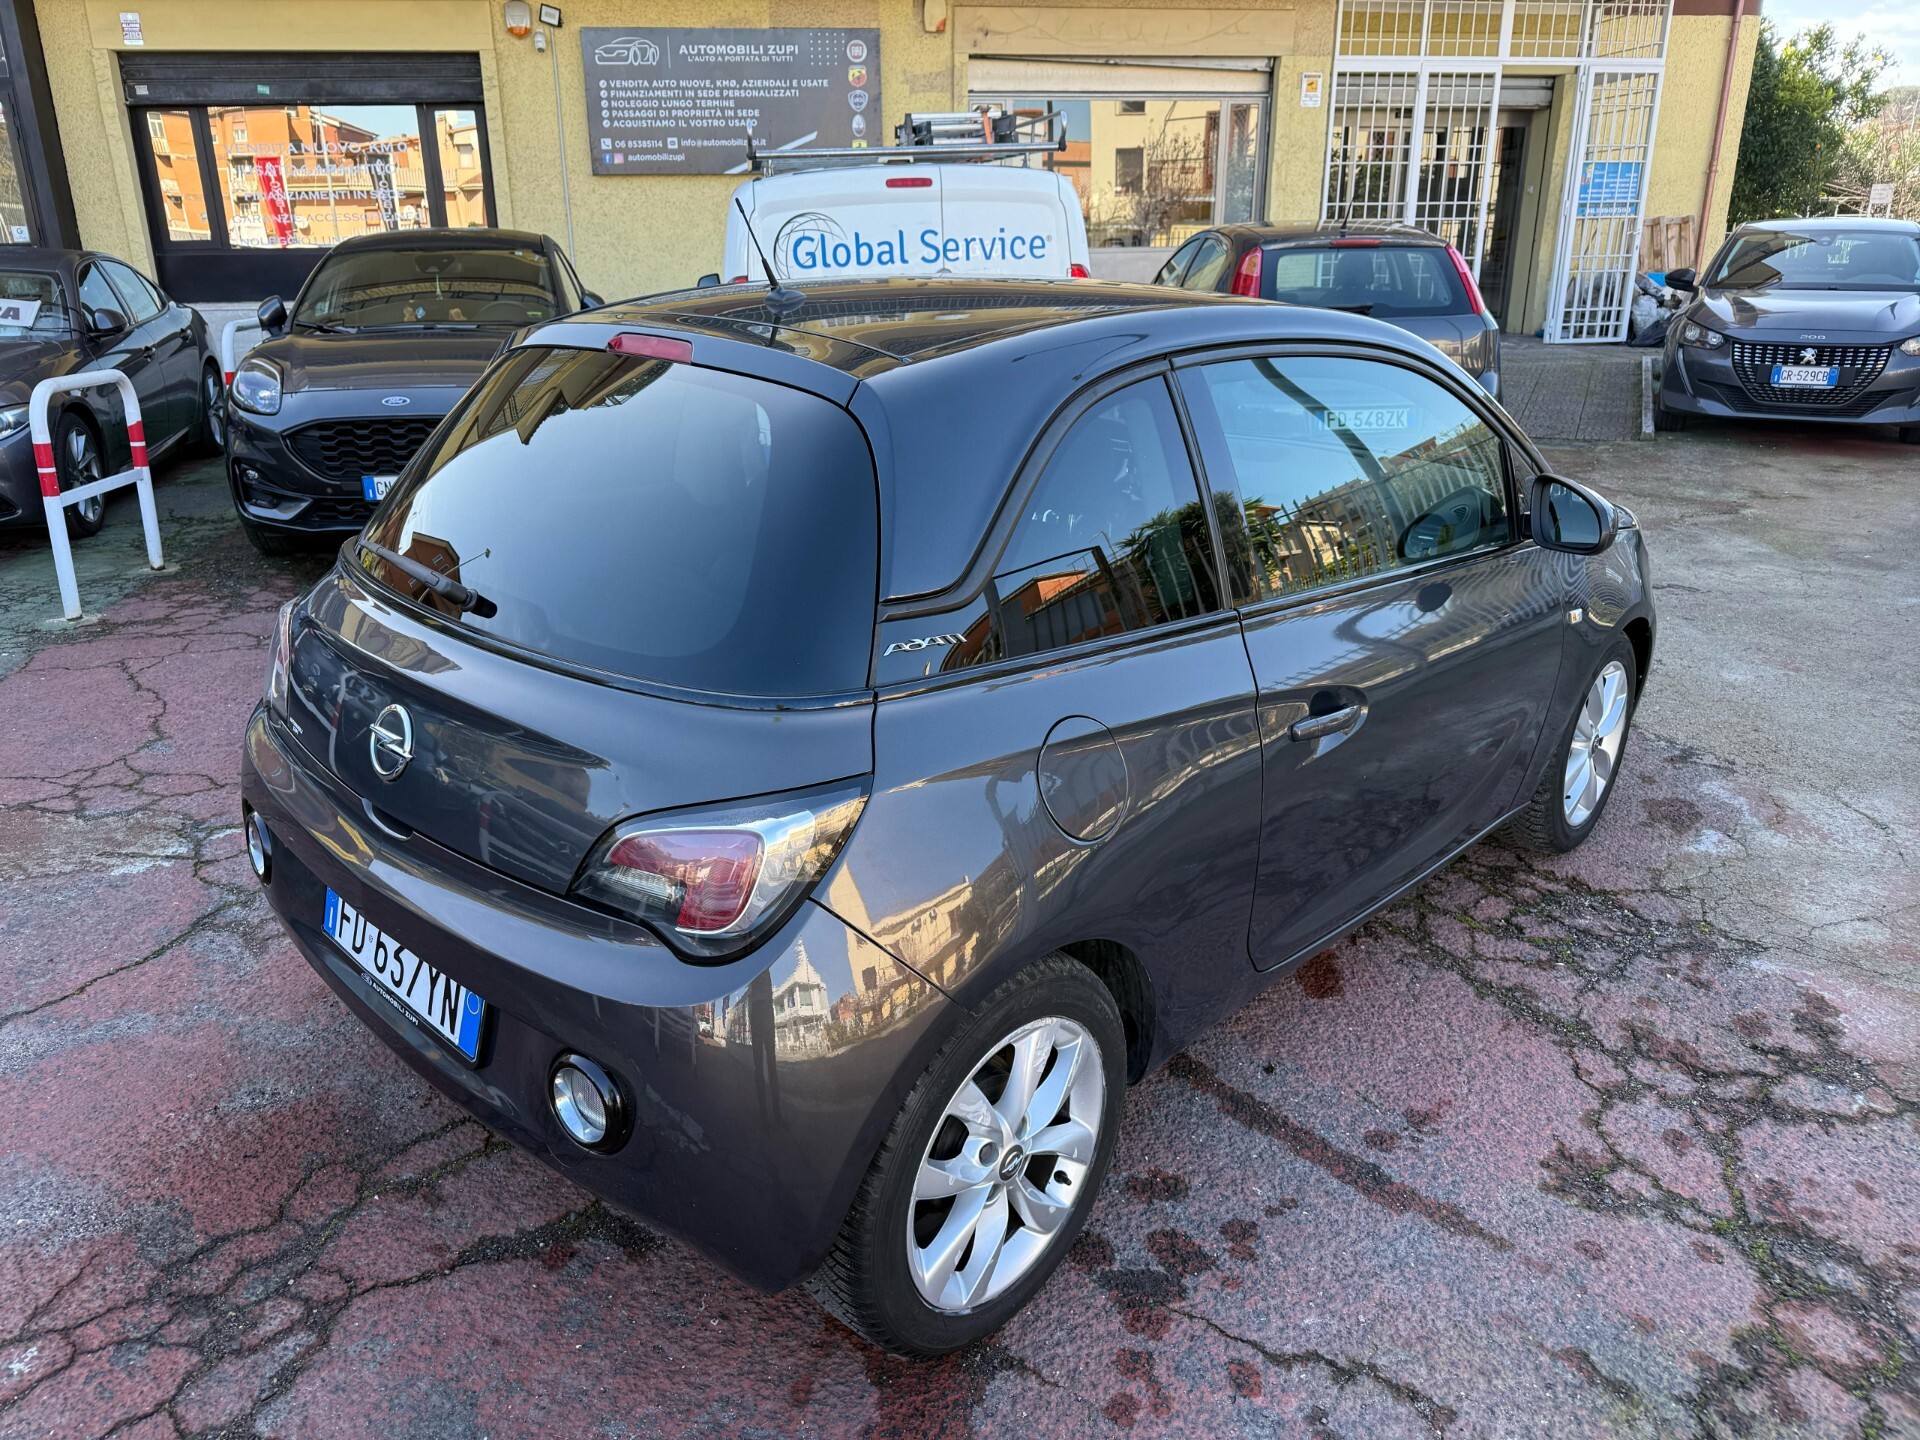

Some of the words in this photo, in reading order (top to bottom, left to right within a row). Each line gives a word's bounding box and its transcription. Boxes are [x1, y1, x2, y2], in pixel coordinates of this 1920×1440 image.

[679, 45, 764, 55] AUTOMOBILI
[767, 45, 799, 55] ZUPI
[609, 80, 650, 88] VENDITA
[652, 80, 677, 88] AUTO
[680, 79, 714, 89] NUOVE,
[742, 79, 790, 88] AZIENDALI
[792, 79, 799, 87] E
[800, 79, 829, 87] USATE
[610, 89, 682, 98] FINANZIAMENTI
[685, 89, 695, 98] IN
[697, 89, 721, 98] SEDE
[722, 89, 799, 98] PERSONALIZZATI
[611, 99, 659, 108] NOLEGGIO
[661, 99, 693, 108] LUNGO
[695, 99, 736, 108] TERMINE
[611, 109, 657, 118] PASSAGGI
[659, 109, 669, 118] DI
[671, 107, 723, 118] PROPRIETÀ
[724, 109, 735, 117] IN
[736, 109, 761, 117] SEDE
[612, 119, 676, 128] ACQUISTIAMO
[678, 119, 688, 128] IL
[689, 119, 726, 128] VOSTRO
[728, 119, 758, 128] USAO
[223, 142, 299, 154] VENDITA
[300, 142, 366, 156] NUOVO,
[368, 142, 394, 154] KM
[398, 142, 407, 152] 0
[614, 140, 626, 149] 06
[627, 140, 663, 149] 85385114
[680, 138, 767, 148] info@automobilizpi.it
[627, 152, 686, 162] automobilizupi
[241, 163, 297, 176] USATO
[243, 190, 351, 201] FINANZIAMENTI
[353, 190, 368, 200] IN
[232, 212, 303, 225] GARANZIE
[792, 229, 909, 270] Global
[372, 983, 405, 1014] AUTOMOBILI
[405, 1010, 419, 1026] ZUPI
